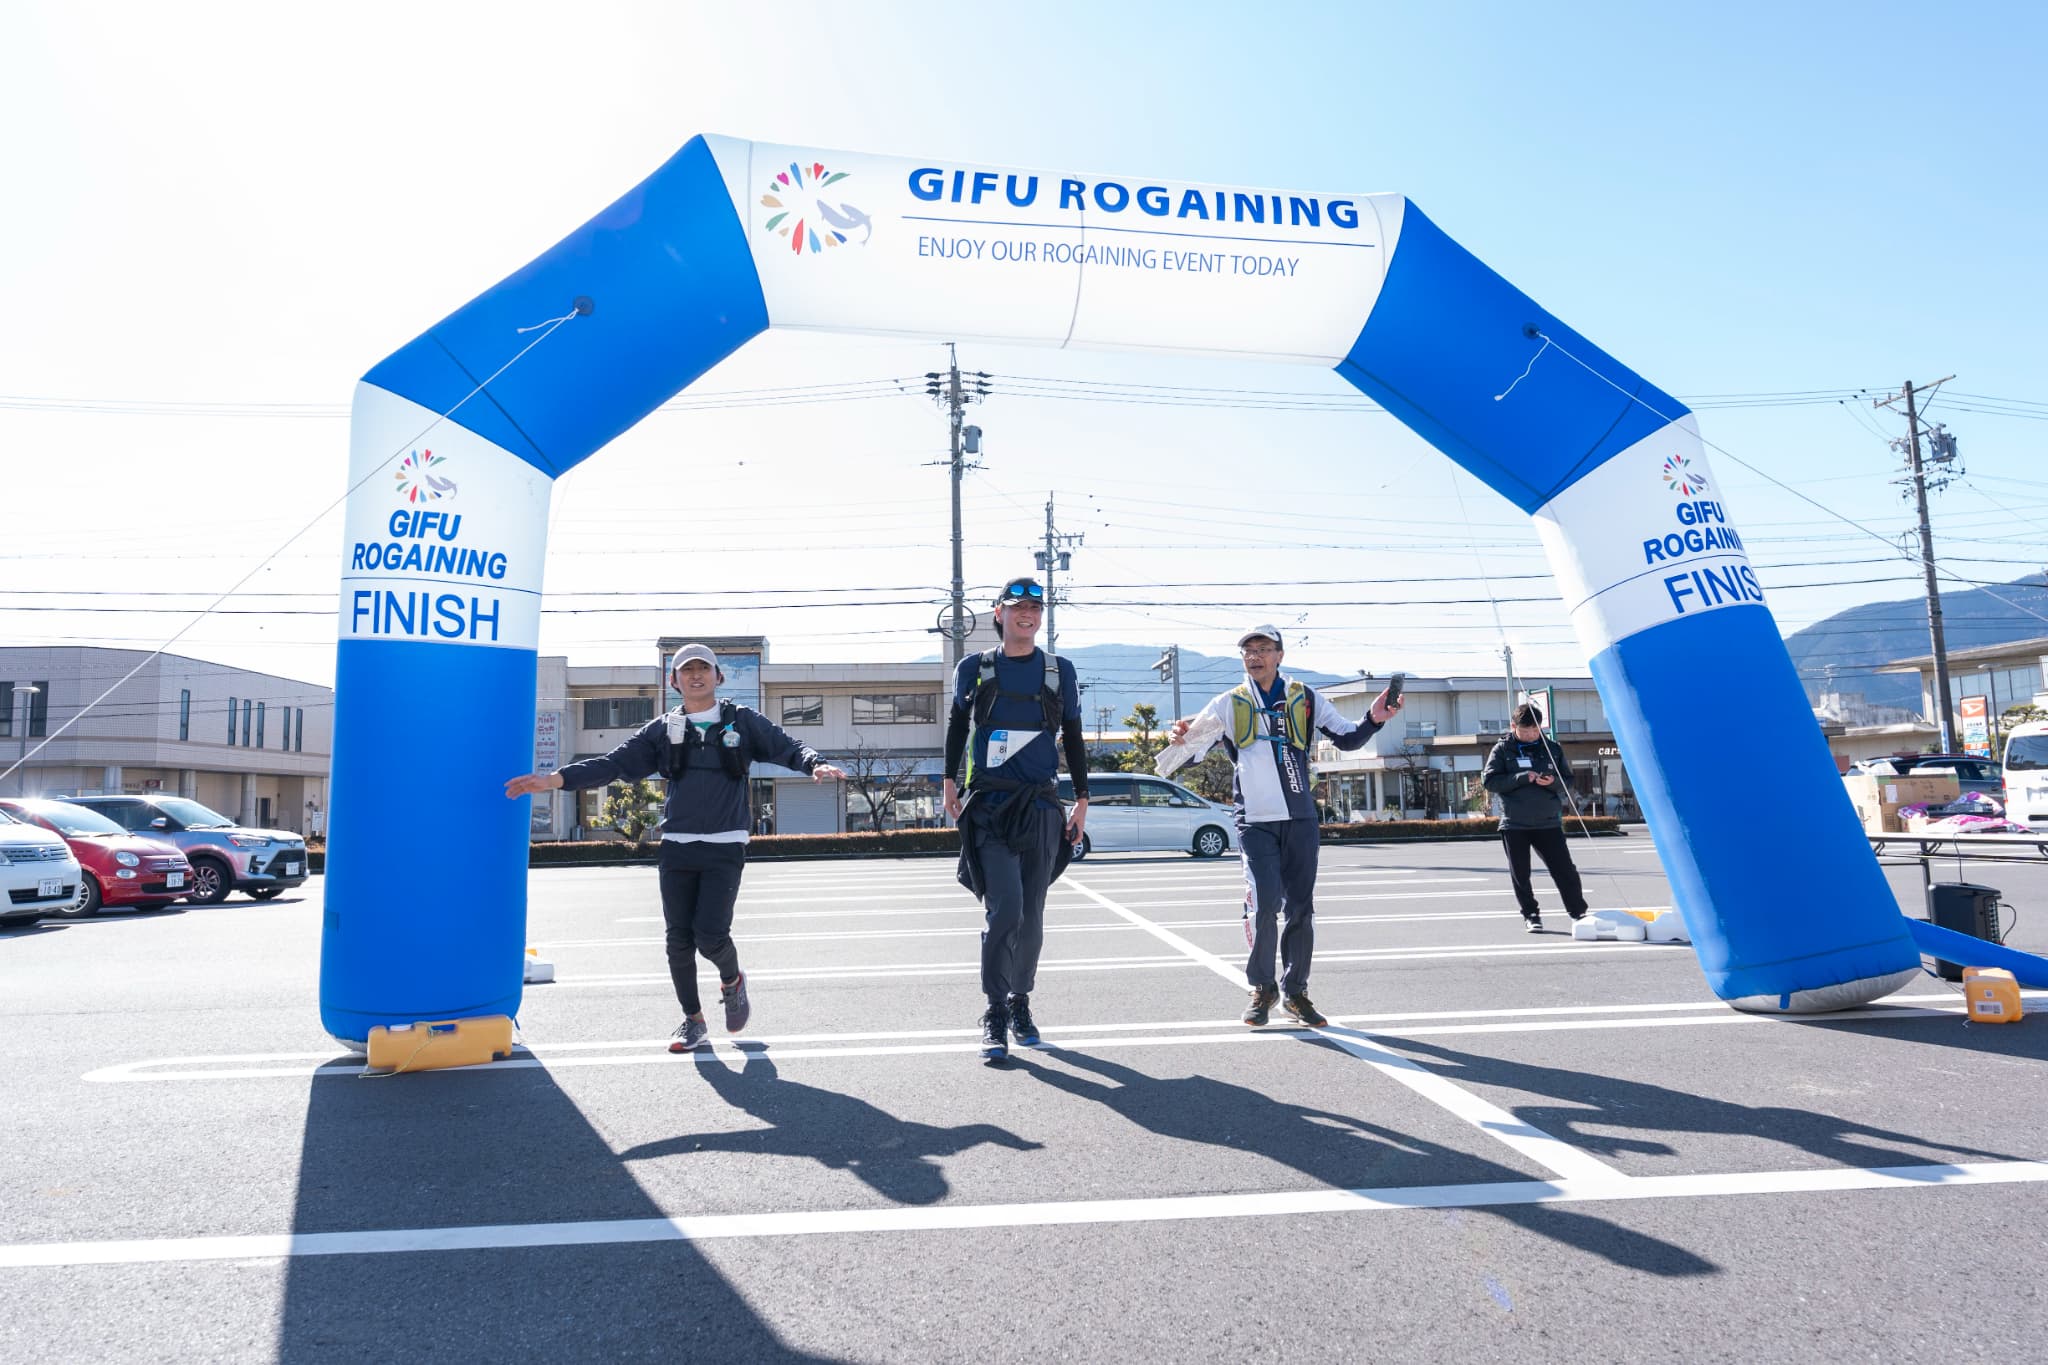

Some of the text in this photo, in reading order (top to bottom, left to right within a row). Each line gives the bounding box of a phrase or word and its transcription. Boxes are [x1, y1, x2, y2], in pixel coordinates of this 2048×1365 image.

[908, 168, 1359, 229] GIFU ROGAINING
[918, 236, 1300, 277] ENJOY OUR ROGAINING EVENT TODAY
[389, 509, 462, 541] GIFU
[1676, 501, 1725, 526] GIFU
[352, 542, 508, 580] ROGAINING
[353, 590, 500, 641] FINISH
